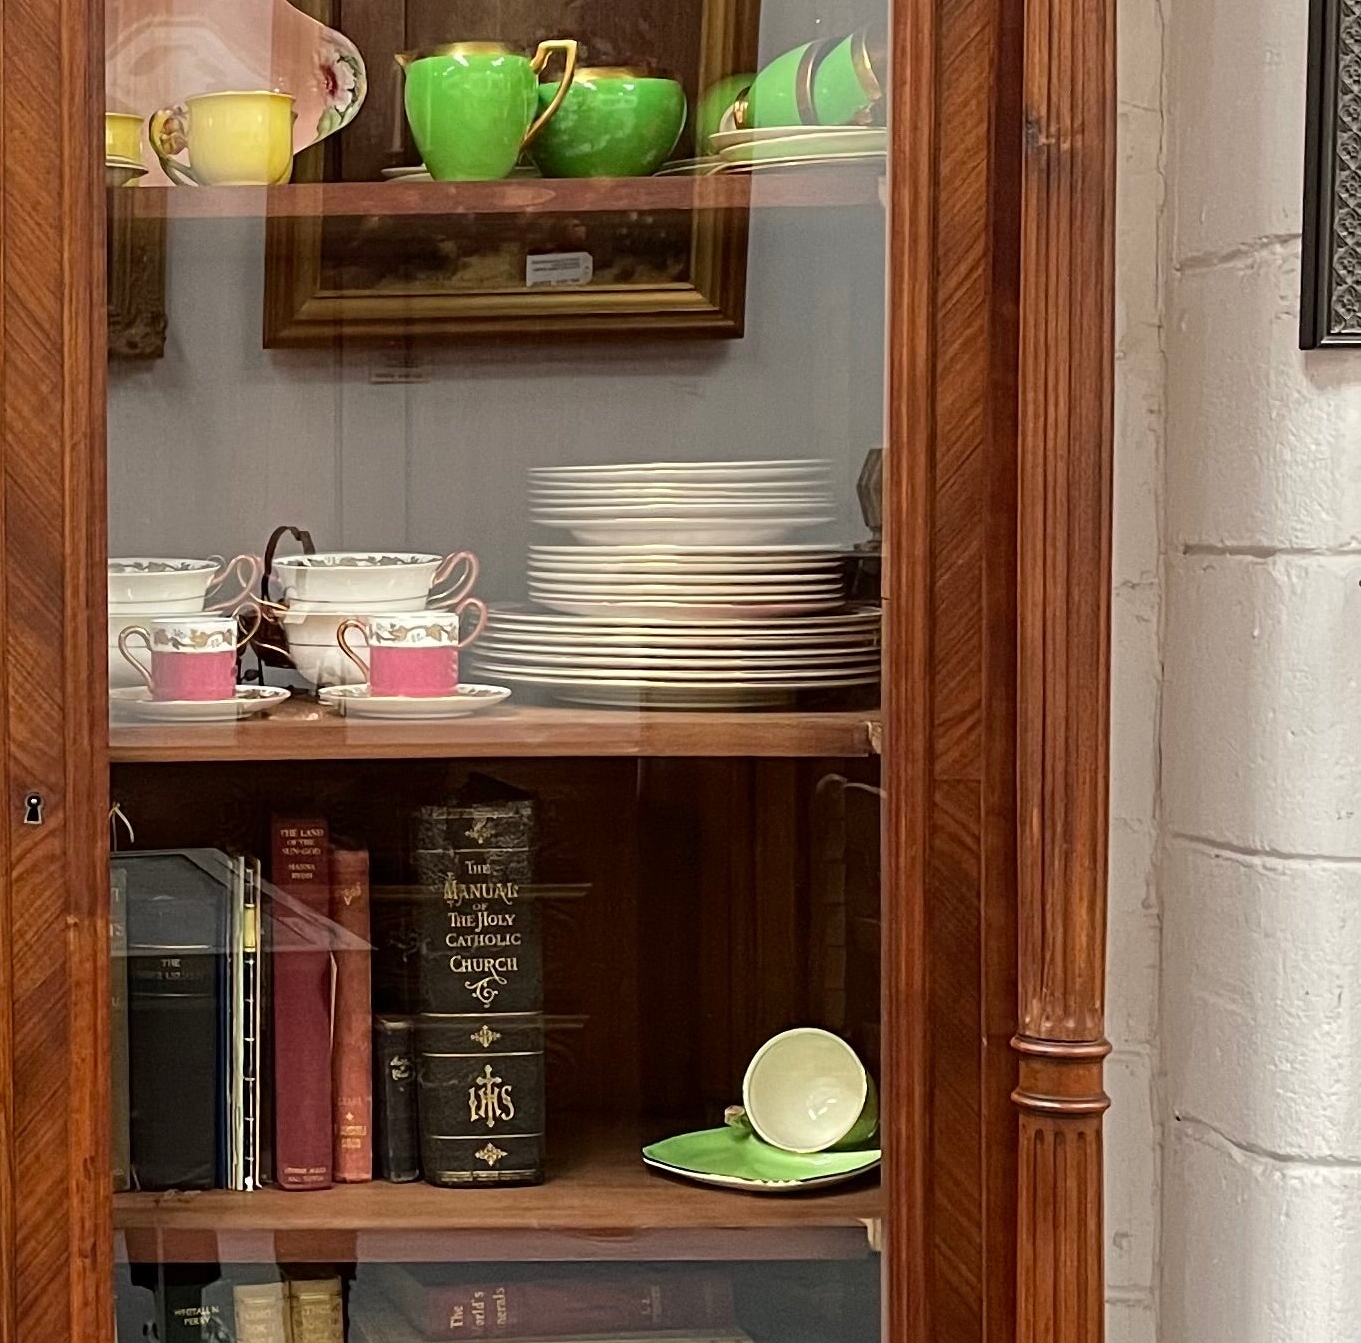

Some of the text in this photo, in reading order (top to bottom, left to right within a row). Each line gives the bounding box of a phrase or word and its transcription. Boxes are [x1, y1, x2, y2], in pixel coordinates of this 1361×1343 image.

[299, 828, 325, 838] LAND
[465, 860, 491, 875] THE
[472, 902, 489, 911] OF
[447, 911, 516, 932] THE HOLY
[445, 932, 522, 948] CATHOLIC
[449, 955, 519, 975] CHURCH
[450, 1304, 465, 1330] The
[471, 1290, 486, 1330] orld's
[491, 1286, 506, 1329] nerals
